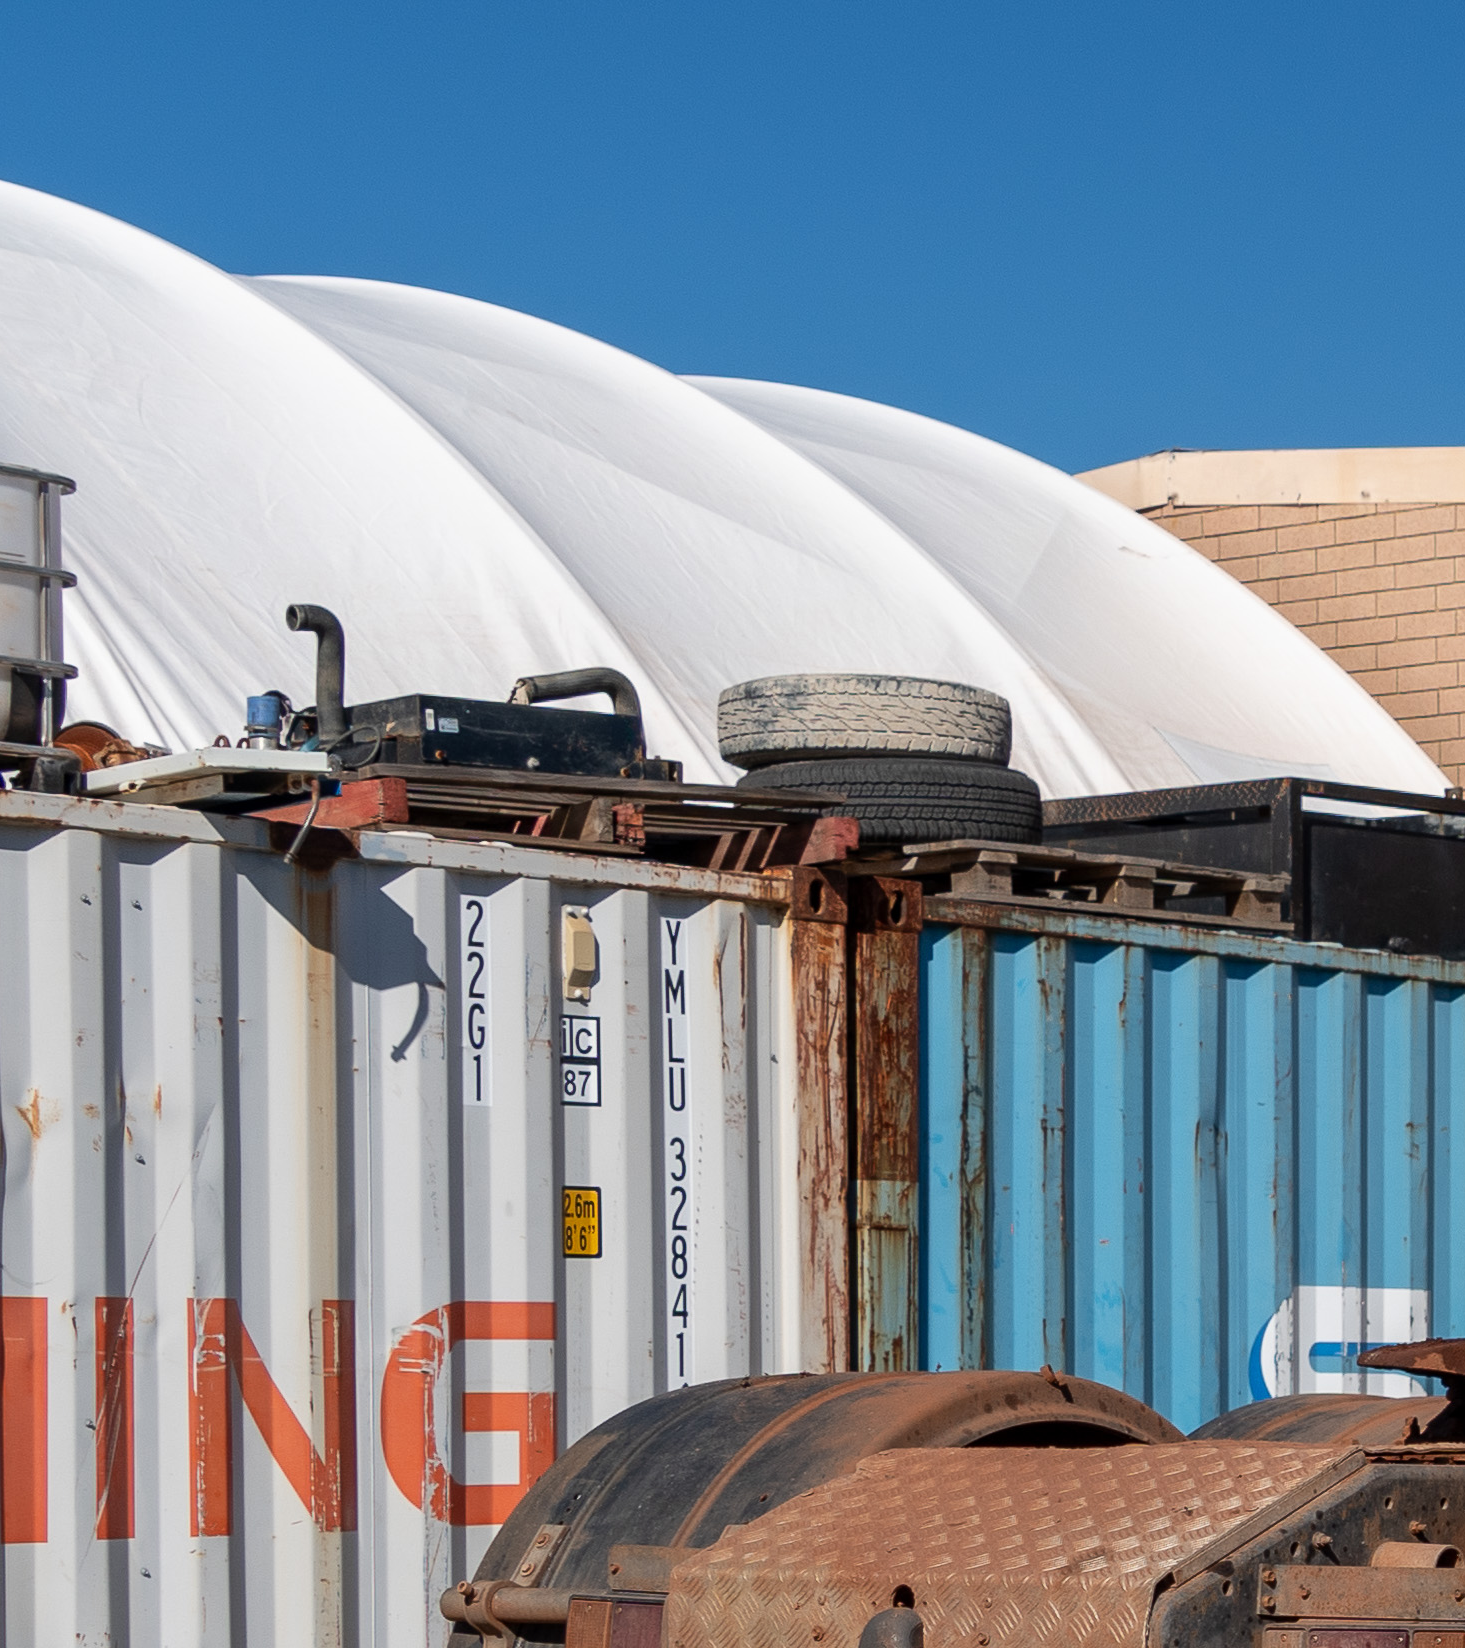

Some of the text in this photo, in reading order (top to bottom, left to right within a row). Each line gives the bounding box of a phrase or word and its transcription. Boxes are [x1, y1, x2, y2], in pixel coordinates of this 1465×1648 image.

[466, 899, 486, 1102] 22G1
[564, 1069, 592, 1096] 87
[664, 919, 689, 1389] YMLU 32841
